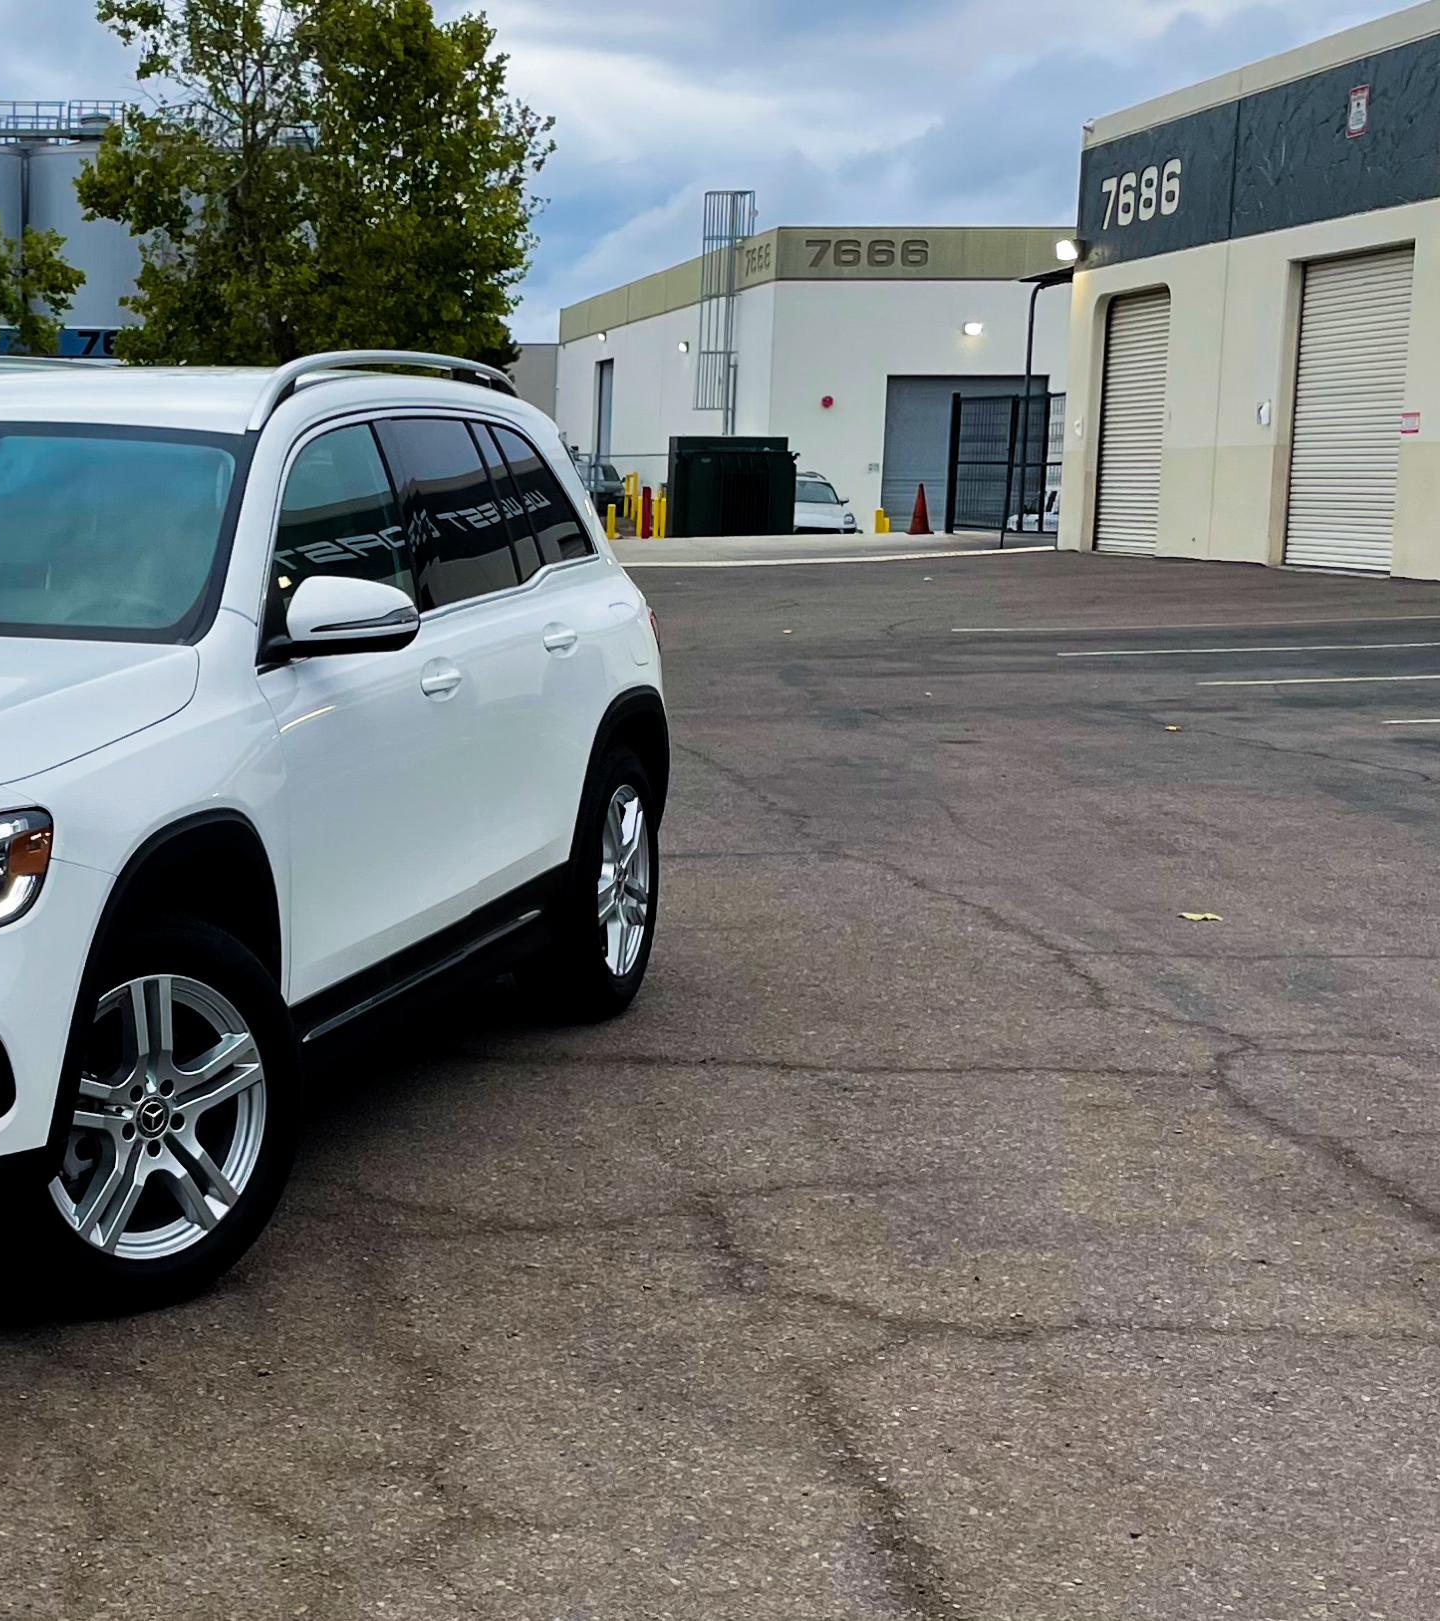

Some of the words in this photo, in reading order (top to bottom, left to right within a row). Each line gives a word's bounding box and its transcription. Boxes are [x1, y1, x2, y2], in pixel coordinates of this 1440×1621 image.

[1102, 158, 1182, 230] 7686
[745, 243, 772, 277] 7666
[805, 239, 930, 268] 7666
